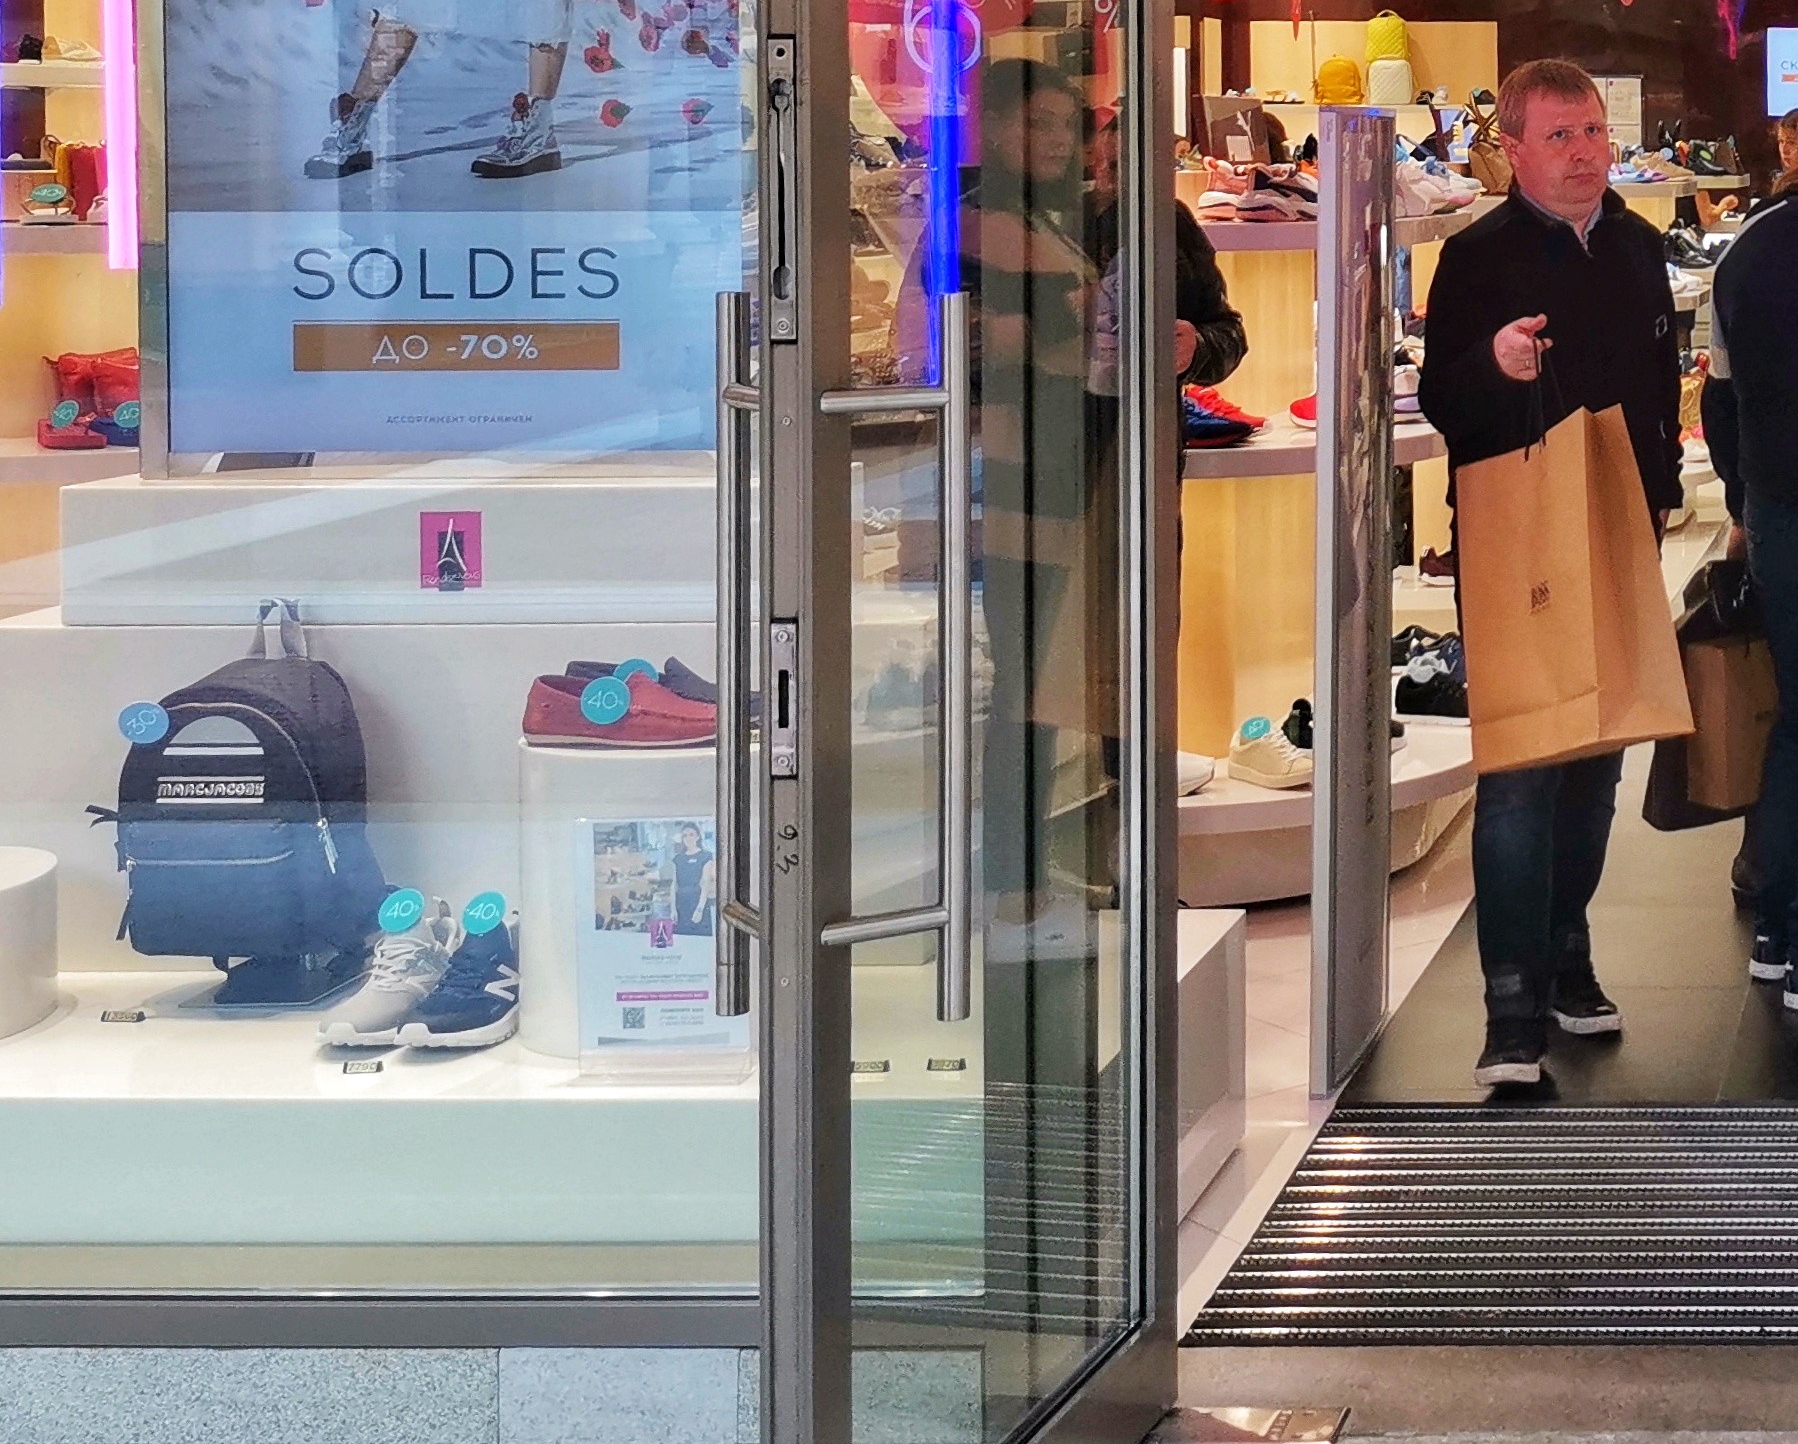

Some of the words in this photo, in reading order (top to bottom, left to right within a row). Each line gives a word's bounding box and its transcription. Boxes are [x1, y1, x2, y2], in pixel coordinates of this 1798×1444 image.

[293, 247, 620, 300] SOLDES
[372, 335, 428, 365] ДО
[446, 334, 539, 360] -70%
